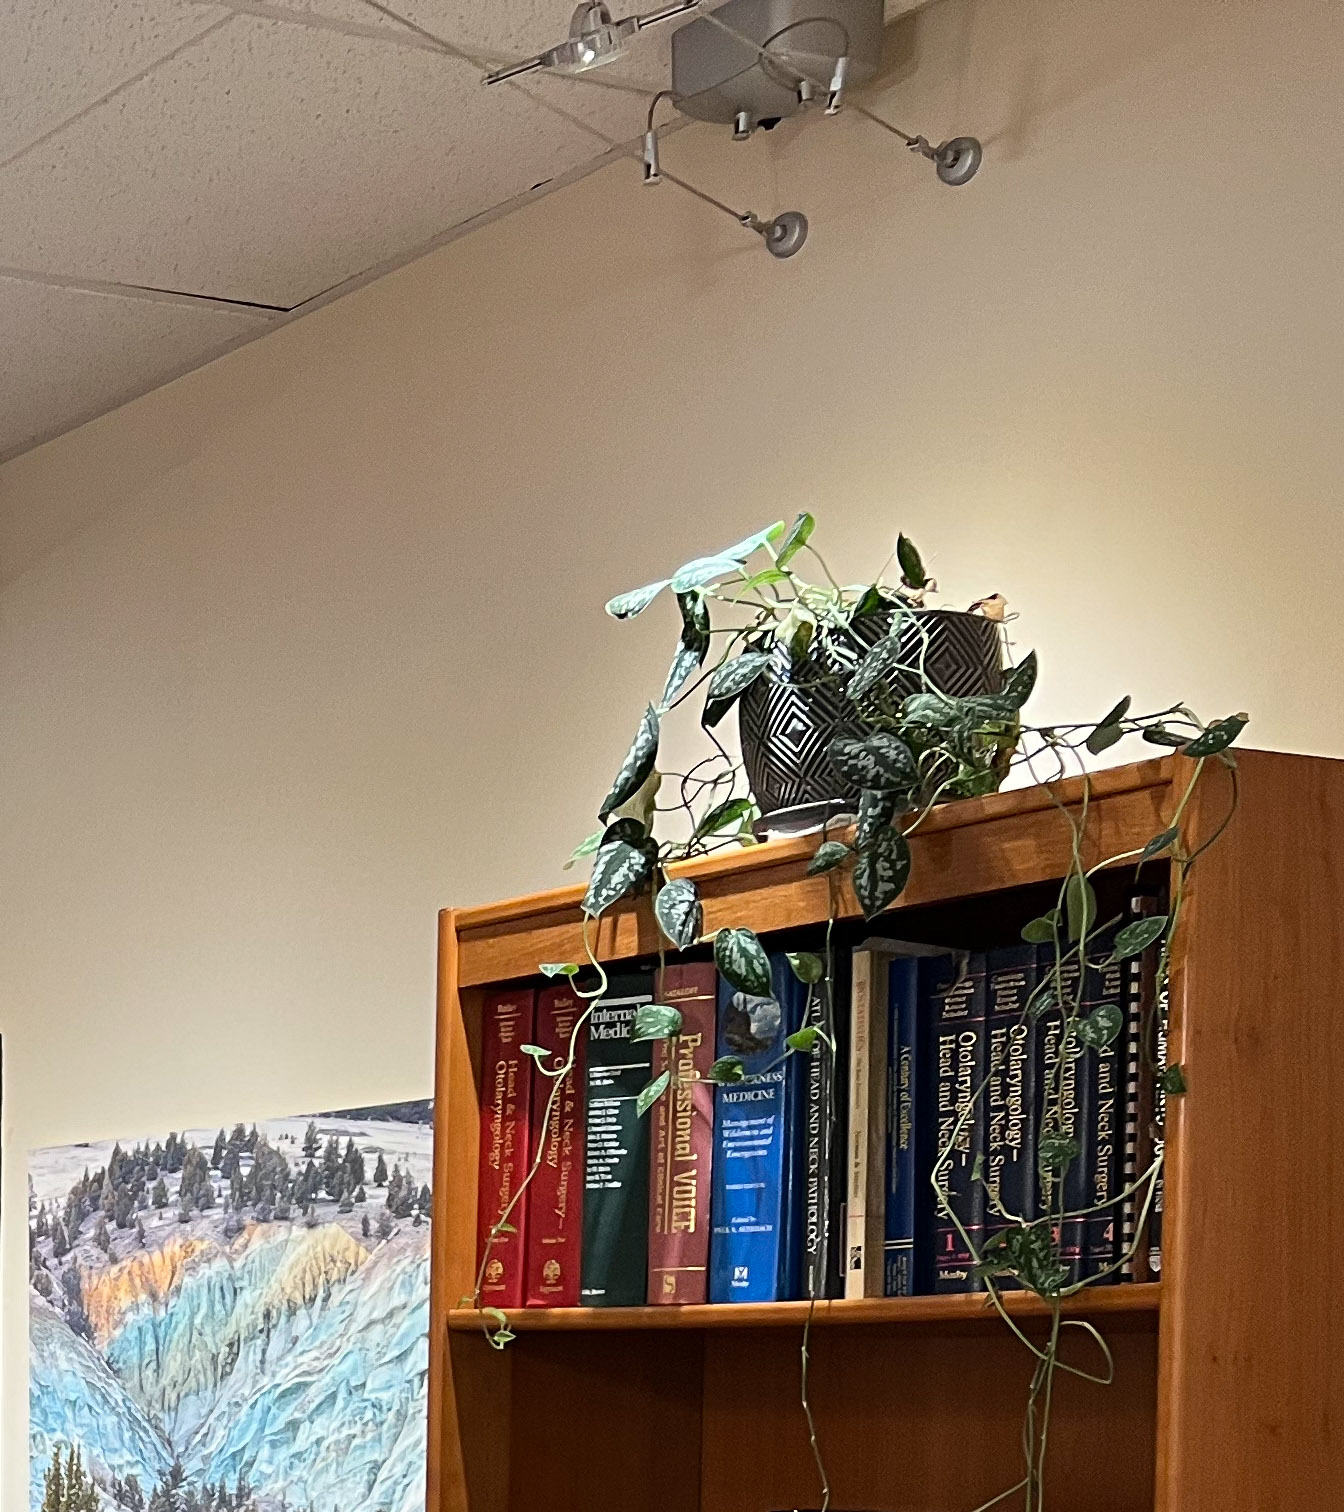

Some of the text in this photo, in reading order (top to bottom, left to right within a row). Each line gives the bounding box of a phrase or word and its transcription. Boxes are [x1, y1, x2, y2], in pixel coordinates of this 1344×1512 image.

[590, 1026, 631, 1040] Medic
[989, 1029, 1007, 1072] Head
[1044, 1020, 1061, 1064] Head
[897, 1054, 911, 1090] Century
[939, 1035, 955, 1076] Head
[506, 1060, 518, 1098] Head
[722, 1088, 776, 1104] MEDICINE
[809, 1062, 820, 1100] HEAD
[900, 1092, 911, 1101] of
[938, 1082, 953, 1111] and
[989, 1076, 1004, 1106] and
[490, 1061, 506, 1170] Otolaryngology
[505, 1104, 514, 1114] &
[565, 1100, 574, 1112] &
[808, 1103, 820, 1133] AND
[503, 1121, 515, 1157] Neck
[562, 1118, 574, 1156] Neck
[671, 1033, 701, 1233] Professional VOICE
[898, 1102, 910, 1150] Excellence
[937, 1118, 953, 1157] Neck
[989, 1112, 1005, 1150] Neck
[1094, 1063, 1113, 1207] and Neck Surgery
[807, 1137, 819, 1173] NECK
[806, 1178, 820, 1254] PATHOLOGY
[944, 1233, 955, 1252] 1
